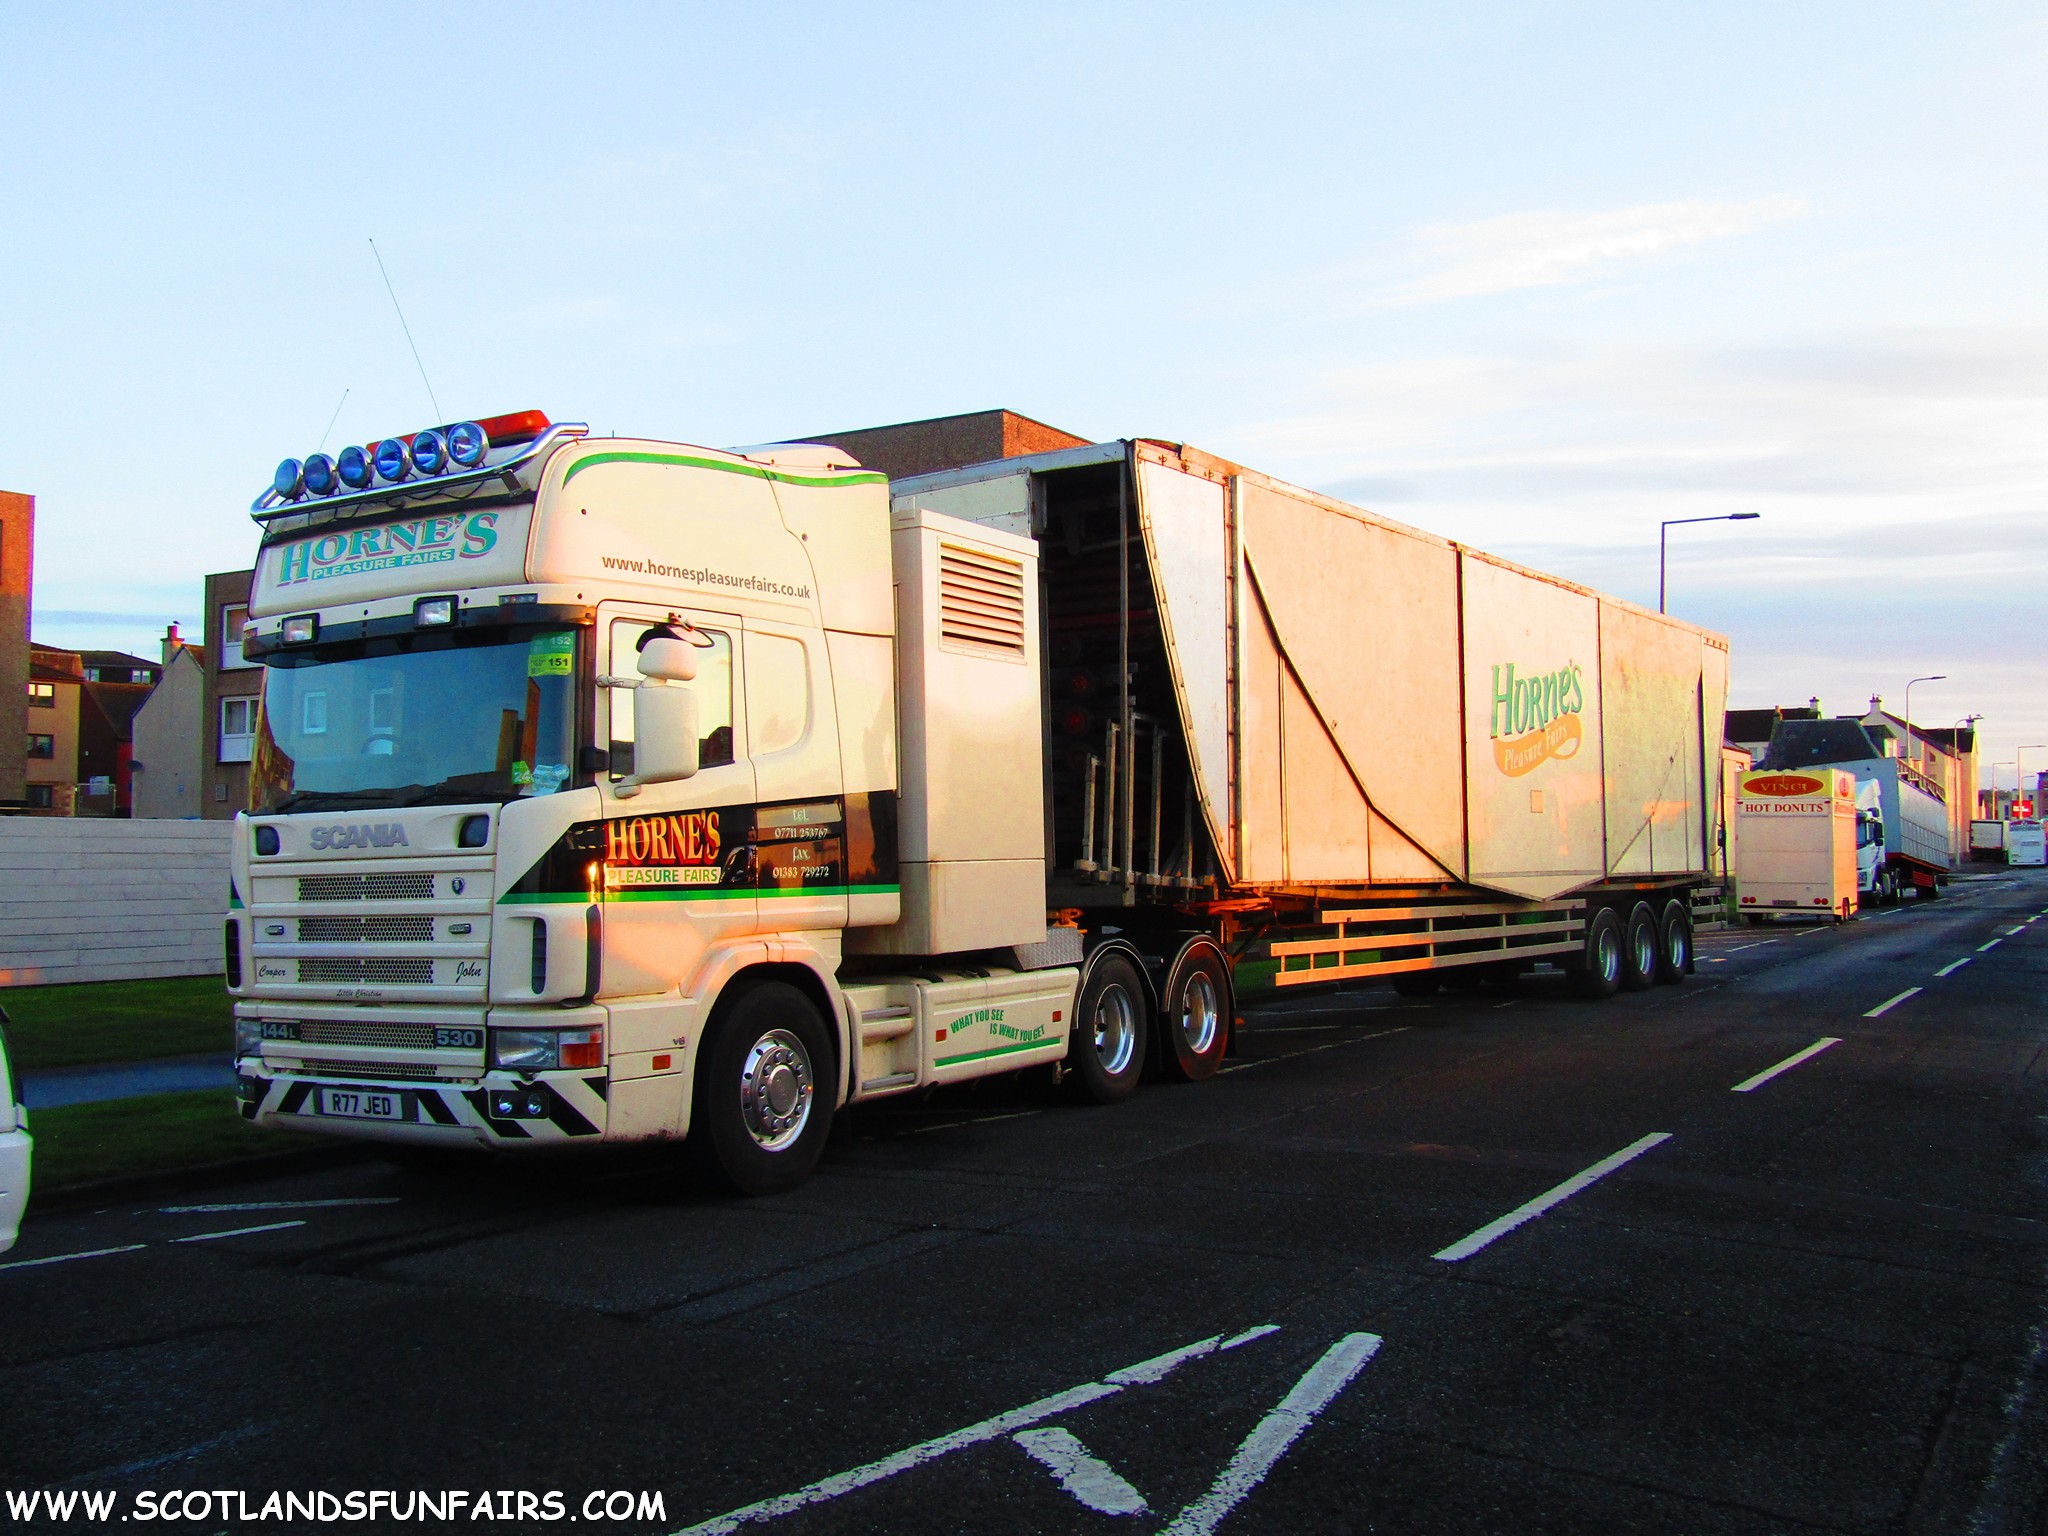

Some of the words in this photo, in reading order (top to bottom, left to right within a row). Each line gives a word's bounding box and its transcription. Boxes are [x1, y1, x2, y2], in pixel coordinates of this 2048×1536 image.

[277, 512, 499, 587] HORNE'S
[313, 557, 396, 579] PLEASURE
[401, 550, 453, 567] FAIRS
[602, 556, 811, 599] www.hornespleasurefairs.co.uk
[549, 658, 568, 666] 151
[1504, 740, 1543, 771] Pleasure
[1546, 723, 1568, 750] Fairs
[1746, 804, 1771, 813] HOT
[1775, 803, 1824, 813] DONUTS
[310, 823, 409, 850] SCANIA
[606, 809, 720, 862] HORNE'S
[608, 869, 679, 884] PLEASURE
[684, 868, 718, 882] FAIRS
[258, 964, 286, 977] Cooper
[456, 961, 482, 983] John
[951, 1013, 973, 1033] WHAT
[975, 1009, 989, 1022] YOU
[991, 1009, 1004, 1020] SEE
[990, 1023, 998, 1034] IS
[999, 1023, 1019, 1039] WHAT
[1020, 1029, 1032, 1041] YOU
[1033, 1024, 1045, 1039] GET
[437, 1029, 477, 1047] 530
[333, 1093, 359, 1113] R77
[364, 1096, 391, 1115] JED
